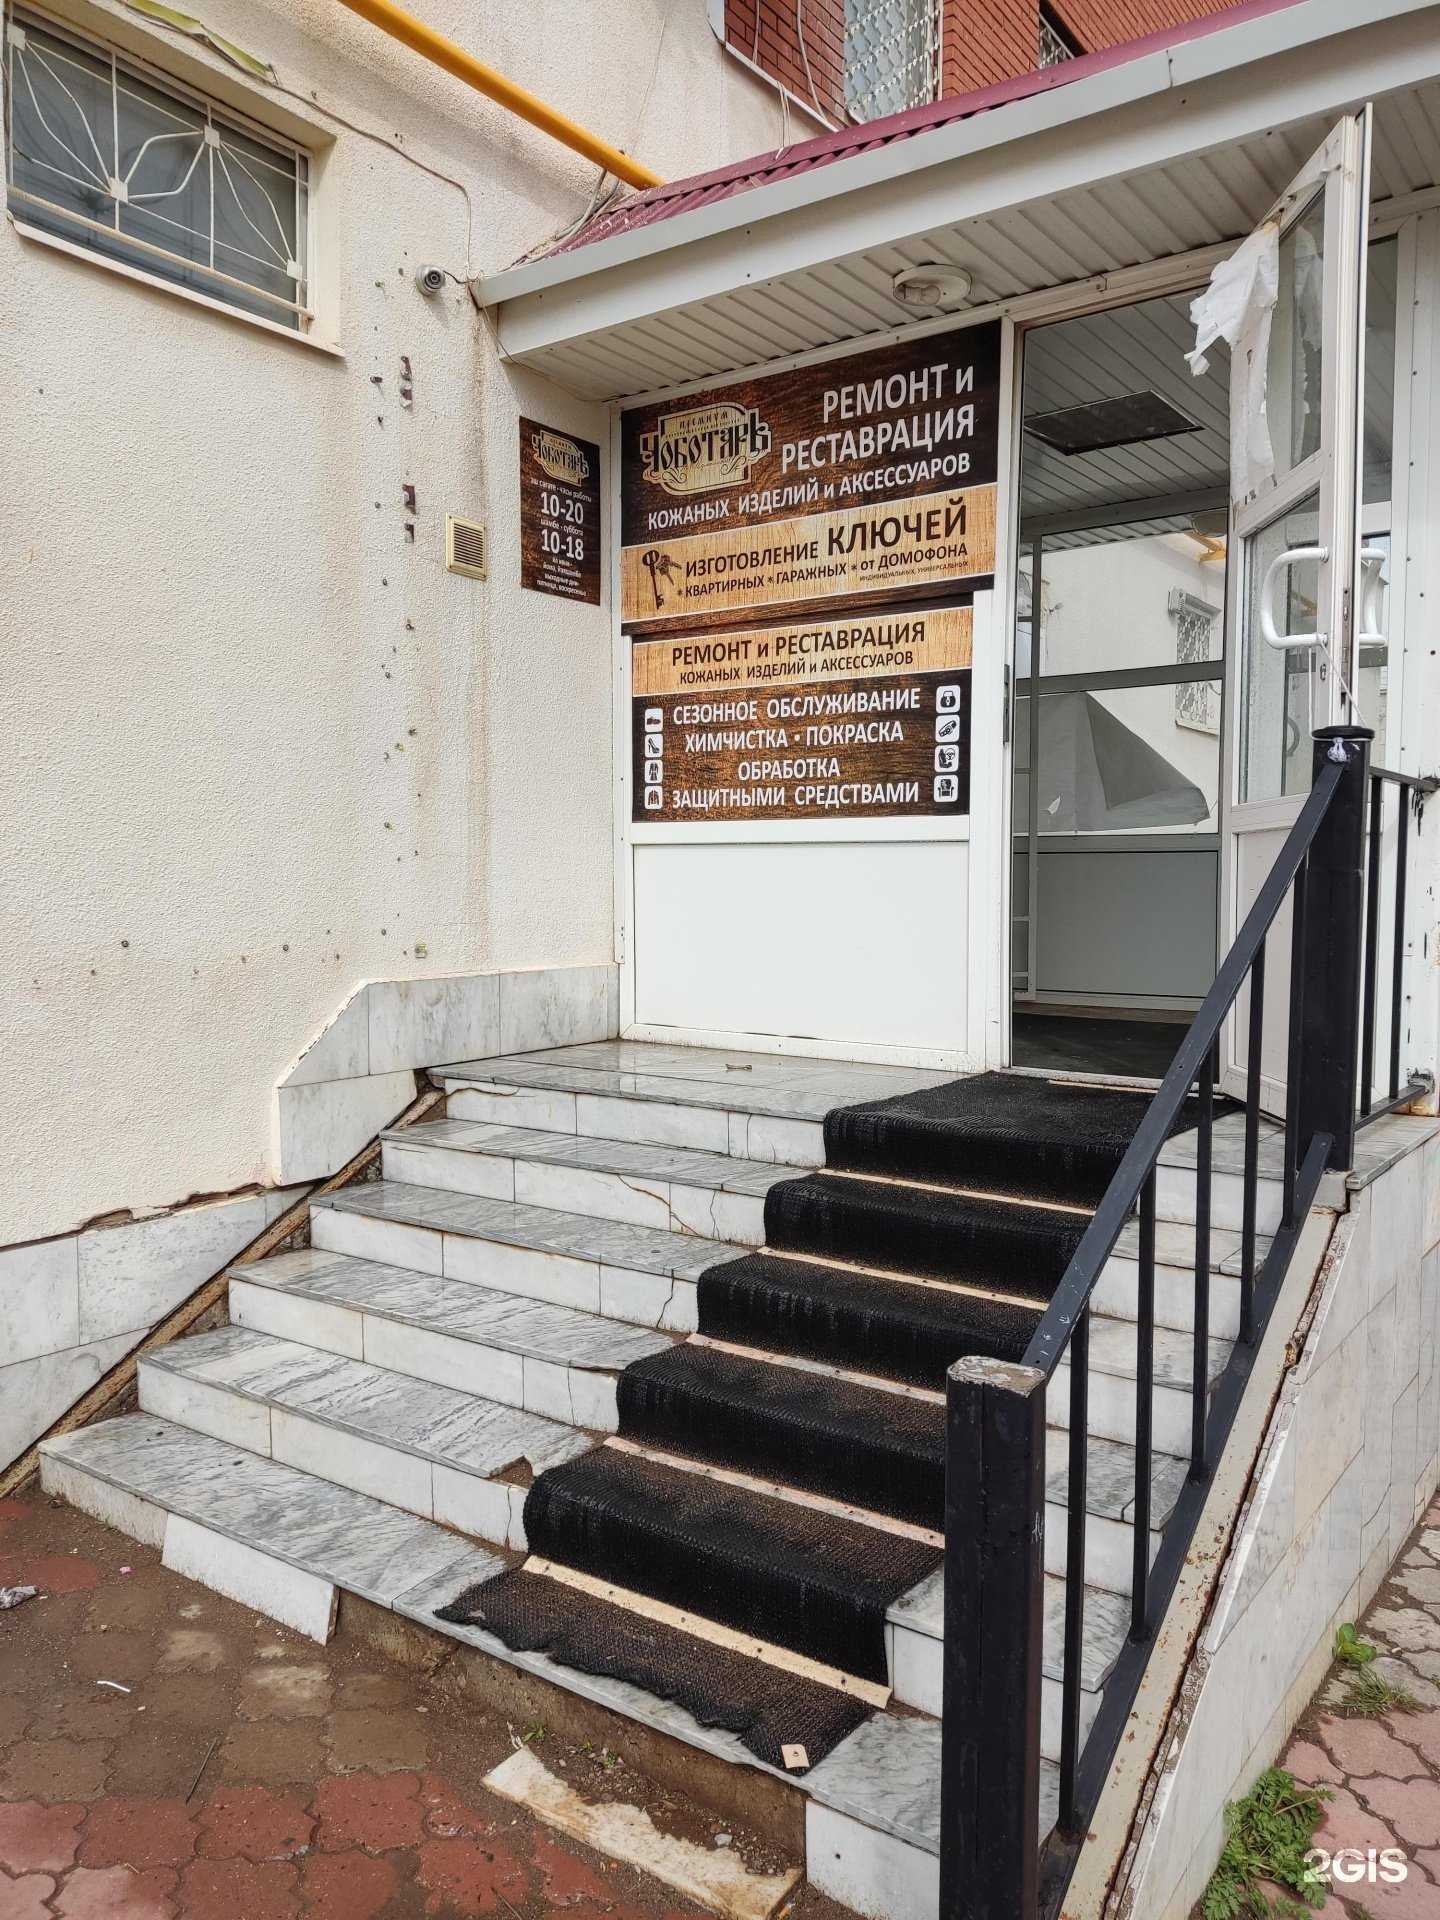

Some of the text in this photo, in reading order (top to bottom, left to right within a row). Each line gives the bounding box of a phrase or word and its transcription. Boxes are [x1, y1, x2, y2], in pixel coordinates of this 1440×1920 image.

[823, 363, 974, 423] РЕМОНТ и
[781, 403, 975, 474] РЕСТАВРАЦИЯ
[540, 491, 585, 525] 10-20
[648, 452, 971, 530] КОЖАНЫХ ИЗДЕЛИЙ и АКСЕССУАРОВ
[541, 528, 585, 561] 10-18
[685, 496, 967, 578] ИЗГОТОВЛЕНИЕ КЛЮЧЕЙ
[685, 542, 968, 598] КВАРТИРНЫХ ГАРАЖНЫХ от ДОМОФОНА
[672, 620, 925, 667] РЕМОНТ и РЕСТАВРАЦИЯ
[679, 650, 914, 685] КОЖАНЫХ ИЗДЕЛИЙ и АКСЕССУАРОВ
[672, 687, 921, 726] СЕЗОННОЕ ОБСЛУЖИВАНИЕ
[684, 720, 904, 754] ХИМЧИСТКА ПОКРАСКА
[737, 757, 841, 782] ОБРАБОТКА
[671, 781, 920, 812] ЗАЩИТНЫМИ СРЕДСТВАМИ
